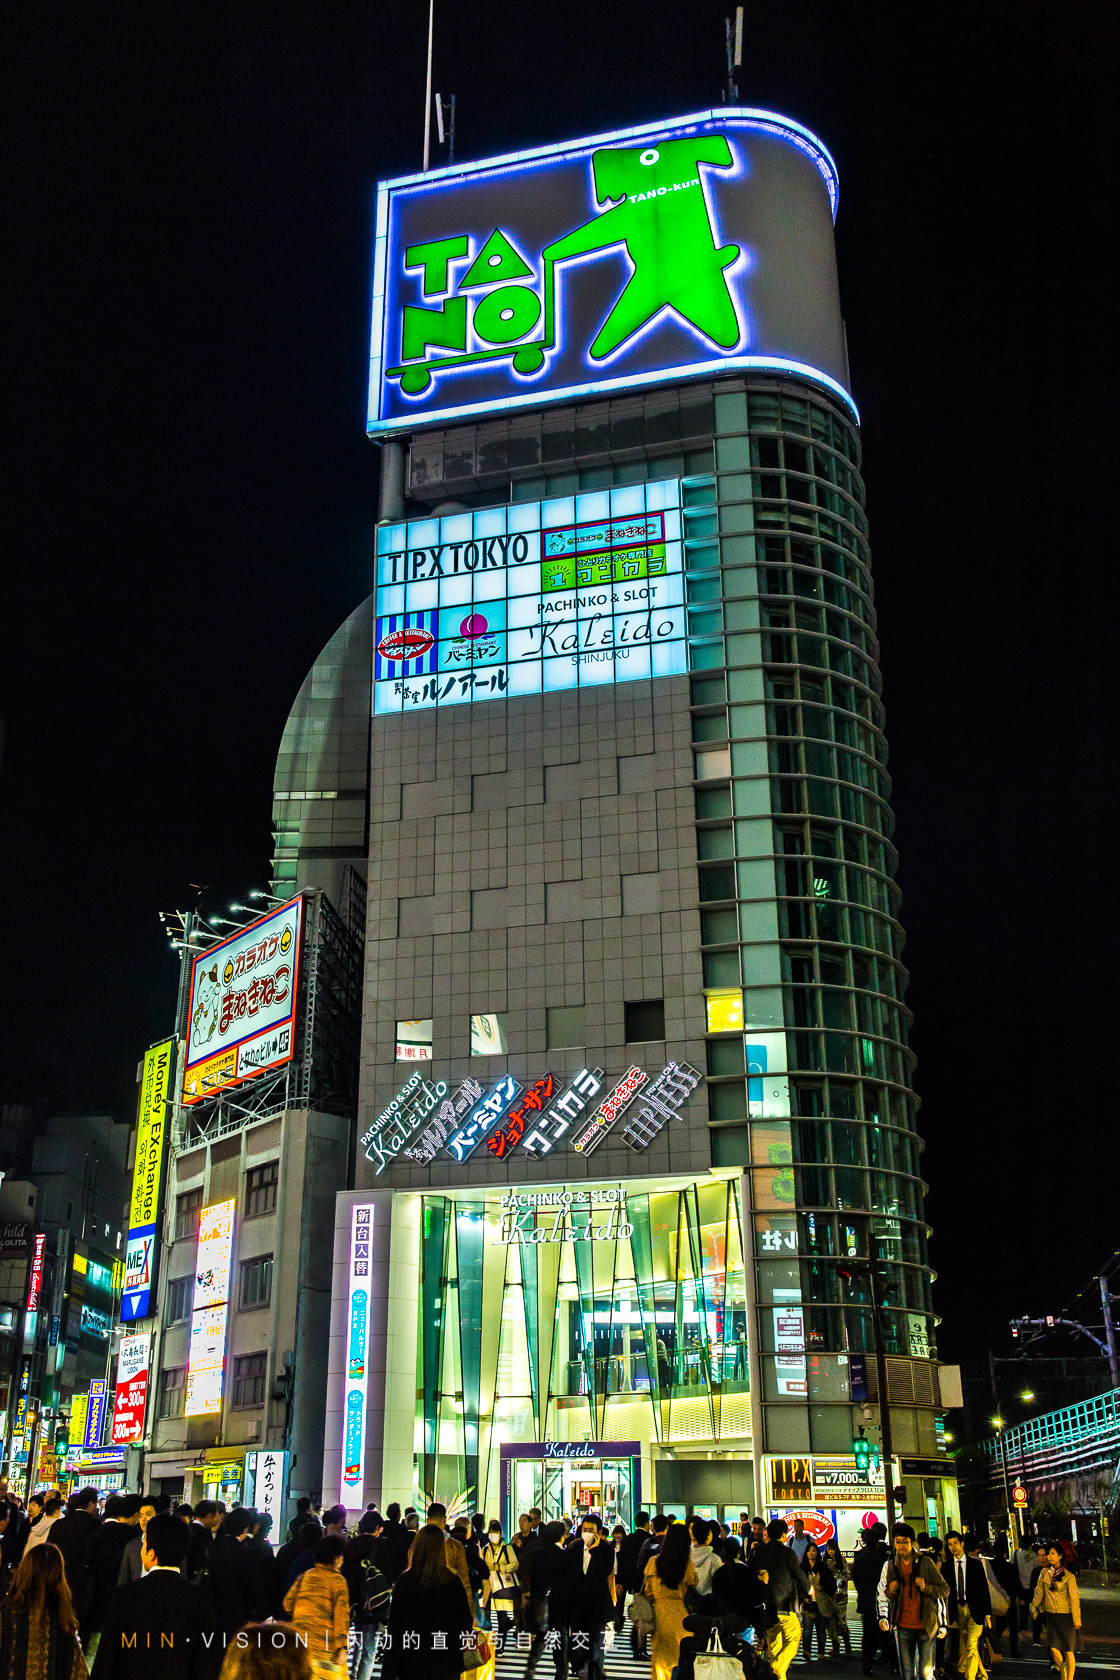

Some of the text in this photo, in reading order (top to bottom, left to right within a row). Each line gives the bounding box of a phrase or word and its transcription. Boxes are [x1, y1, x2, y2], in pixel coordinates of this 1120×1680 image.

[627, 177, 701, 205] TANO-kun
[604, 524, 656, 542] まねきねこ
[450, 533, 530, 574] TOKYO
[577, 549, 653, 568] ひとりカラオケ専門店
[576, 556, 665, 583] ワンカラ
[537, 587, 658, 614] PACHINKO & SLOT
[381, 633, 399, 646] COFFEE
[404, 629, 432, 640] RESTAURANT
[470, 640, 497, 648] RESTAURANT
[521, 605, 675, 657] Kaleido
[444, 645, 501, 664] バーミヤン
[571, 649, 630, 666] SHINJUKU
[422, 669, 510, 702] ルノアール
[234, 936, 279, 976] カラオケ
[218, 964, 291, 1035] まねきねこ
[662, 1061, 677, 1077] Club
[152, 1052, 168, 1115] Money
[360, 1071, 423, 1145] PACHINKO & SLOT
[450, 1076, 516, 1161] バーミヤン
[487, 1074, 553, 1157] ジョナサン
[522, 1068, 601, 1153] ワンカラ
[579, 1067, 647, 1146] カラオケ まねきねこ
[624, 1065, 698, 1147] TIPNESS
[365, 1080, 447, 1176] Kaleido
[500, 1188, 628, 1208] PACHINKO & SLOT
[491, 1206, 635, 1247] Kaleido
[354, 1209, 370, 1276] 新台入替
[543, 1442, 595, 1457] Kaleido
[826, 1473, 858, 1484] ¥7,000
[774, 1488, 811, 1499] TOKYO
[1016, 1491, 1024, 1499] 30
[802, 1512, 832, 1527] RESTAURANT
